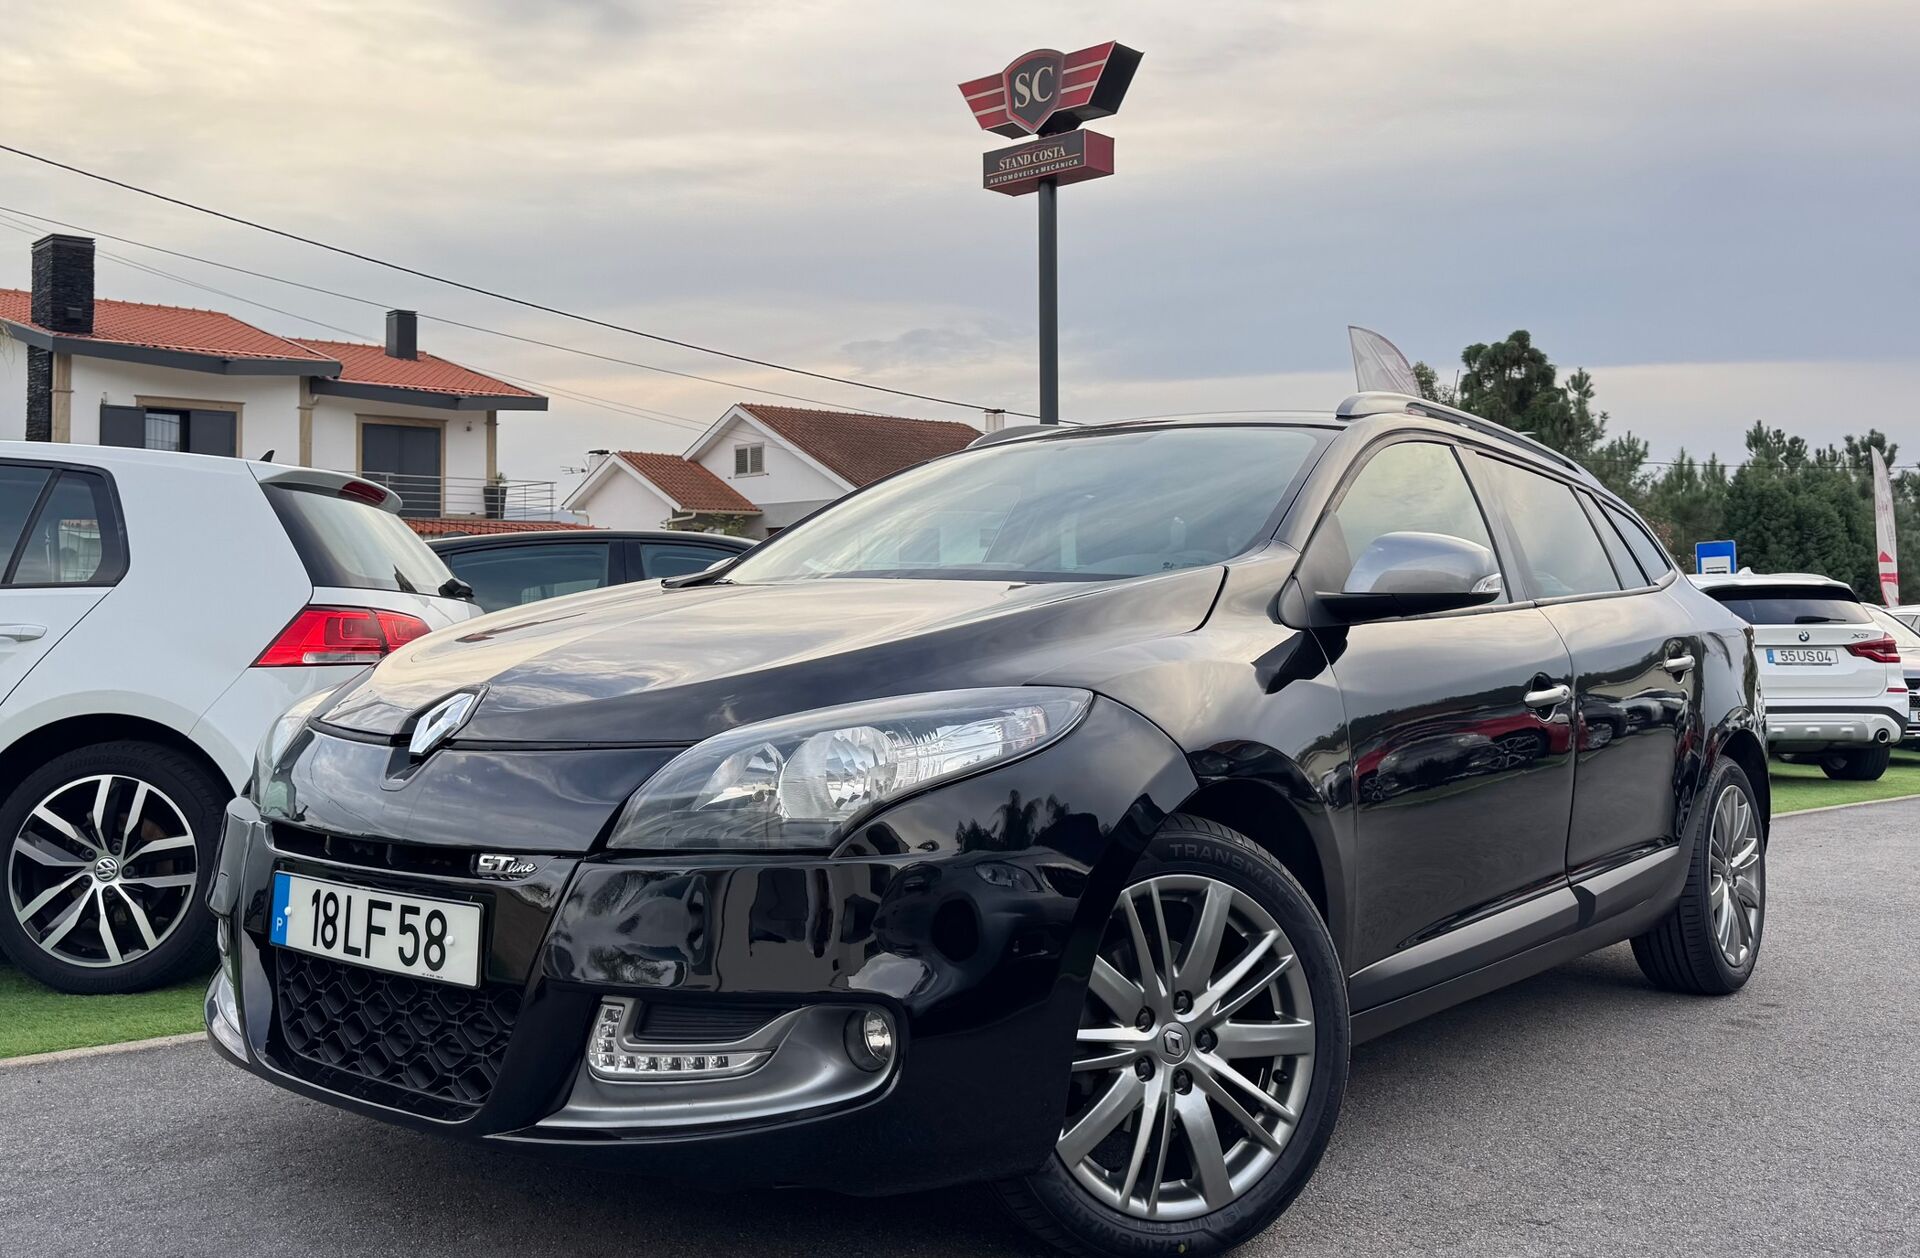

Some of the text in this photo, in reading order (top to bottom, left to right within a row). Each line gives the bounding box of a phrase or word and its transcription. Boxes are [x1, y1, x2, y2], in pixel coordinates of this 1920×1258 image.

[1014, 65, 1054, 109] SC
[989, 168, 1034, 184] AUTOMÓVEIS
[1040, 158, 1079, 173] MECÂNICA
[999, 146, 1066, 171] STAND COSTA
[276, 917, 283, 932] P
